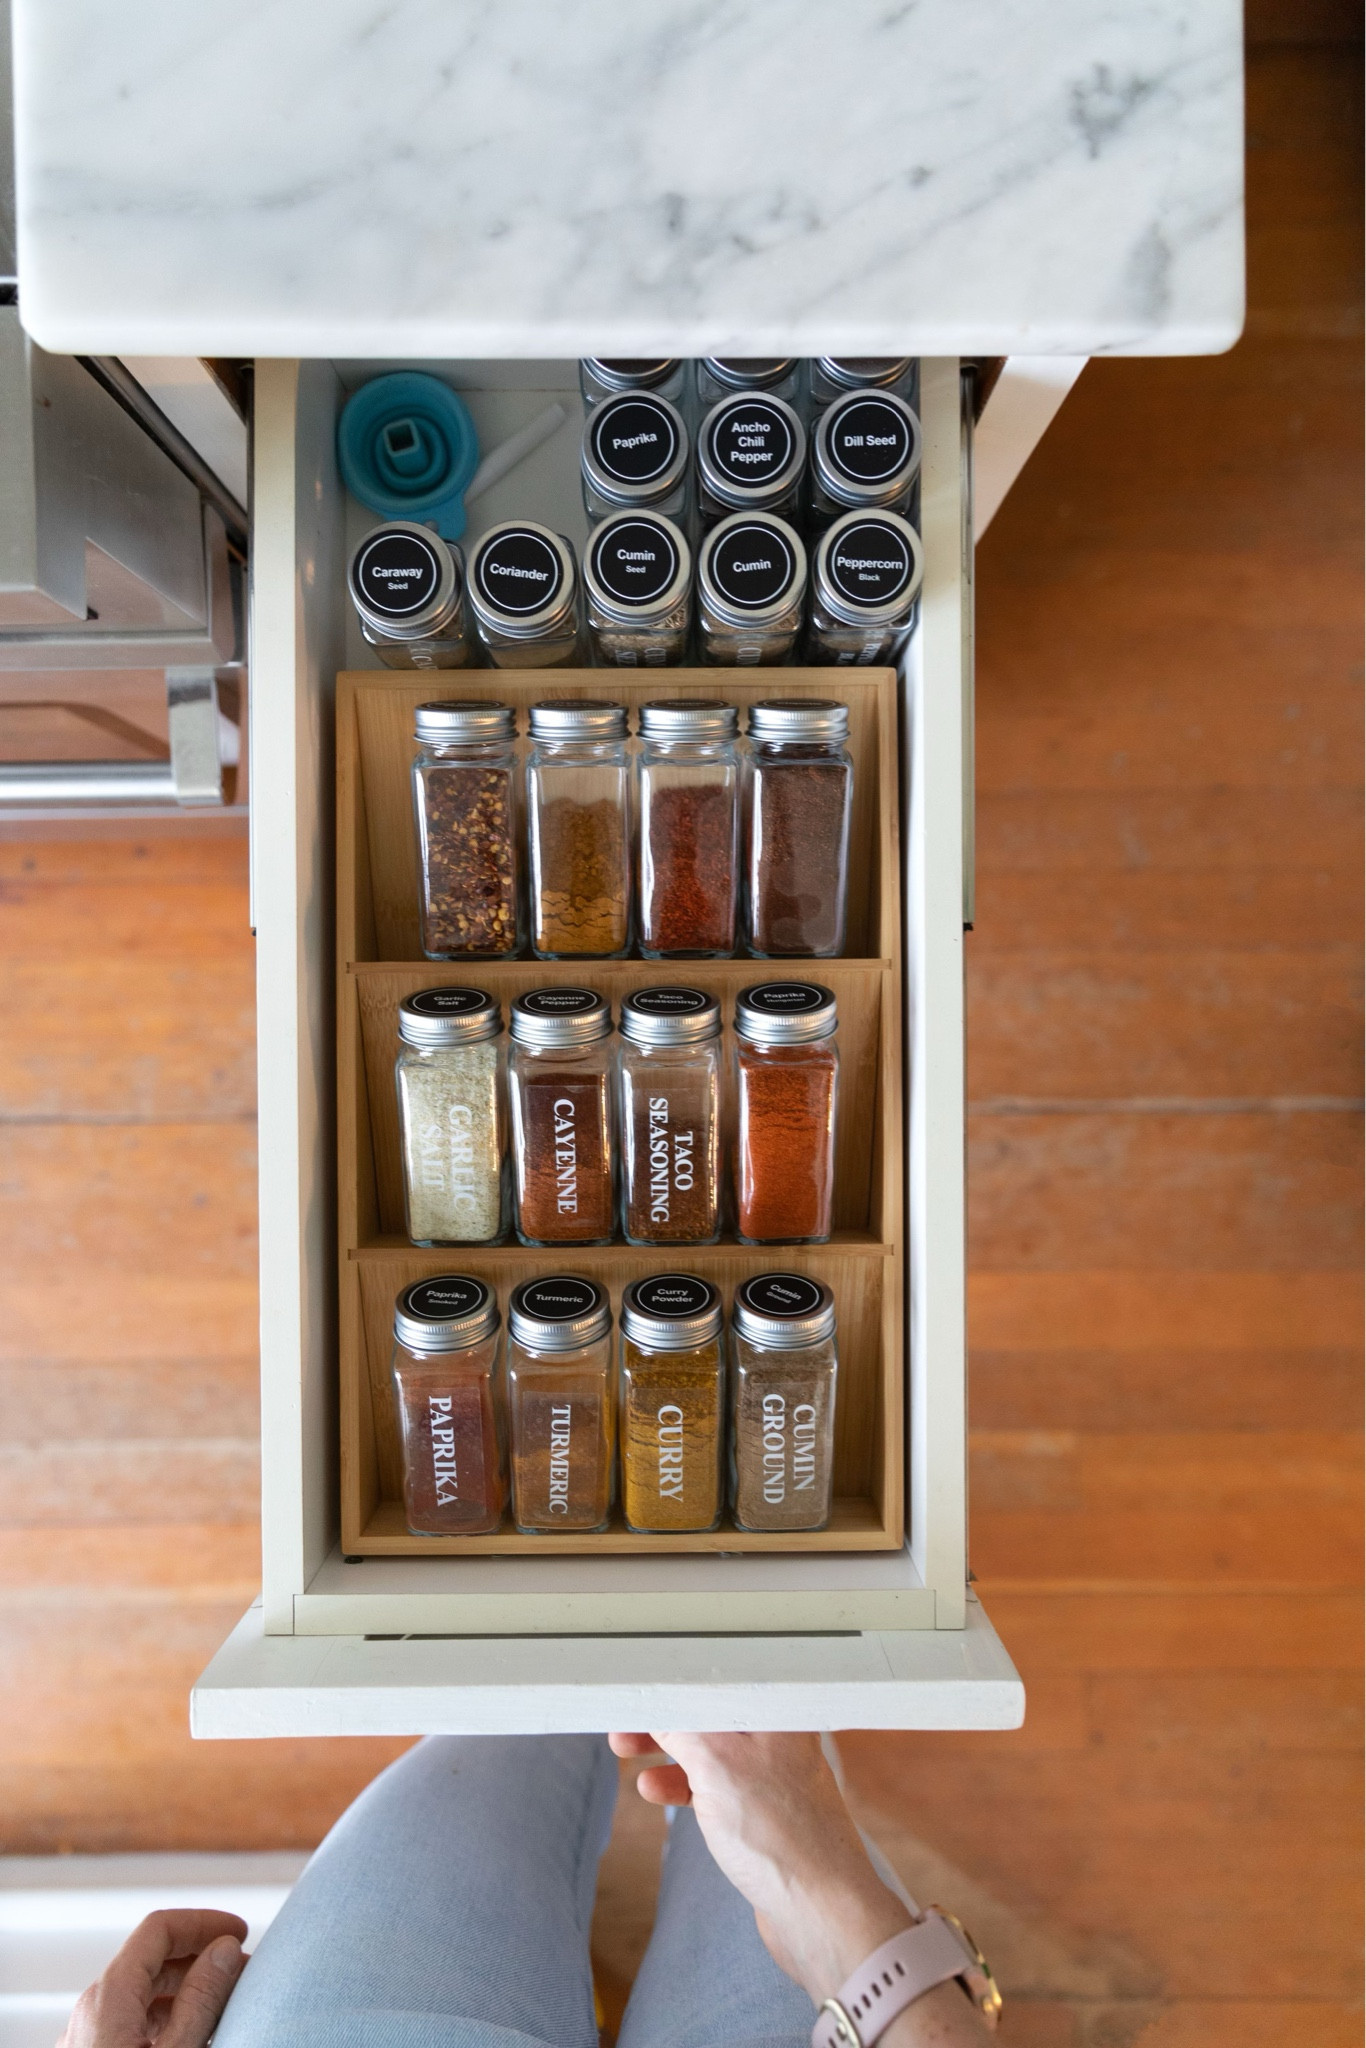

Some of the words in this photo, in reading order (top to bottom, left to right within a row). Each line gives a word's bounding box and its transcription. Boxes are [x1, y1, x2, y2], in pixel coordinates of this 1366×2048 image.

[731, 421, 771, 433] Ancho
[612, 432, 658, 450] Paprika
[738, 435, 765, 447] Chili
[844, 435, 864, 447] Dill
[866, 434, 897, 446] Seed
[730, 450, 773, 463] Pepper
[616, 549, 656, 561] Cumin
[625, 565, 646, 573] Seed
[732, 558, 772, 573] Cumin
[836, 556, 904, 571] Peppercorn
[371, 566, 423, 579] Caraway
[489, 563, 549, 582] Coriander
[858, 573, 881, 581] Black
[387, 581, 409, 590] Seed
[640, 998, 699, 1006] Seasoning
[421, 1124, 446, 1192] SALT
[450, 1104, 478, 1212] GARLIC
[553, 1098, 578, 1215] CAYENNE
[649, 1097, 670, 1224] SEASONING
[674, 1130, 694, 1192] TACO
[426, 1290, 468, 1300] Paprika
[535, 1293, 584, 1303] Turmeric
[651, 1295, 695, 1304] Powder
[656, 1288, 689, 1297] Curry
[769, 1284, 802, 1301] Cumin
[428, 1395, 459, 1507] PAPRIKA
[657, 1404, 684, 1503] CURRY
[762, 1393, 786, 1504] GROUND
[793, 1404, 816, 1491] CUMIN
[548, 1404, 572, 1514] TURMERIC
